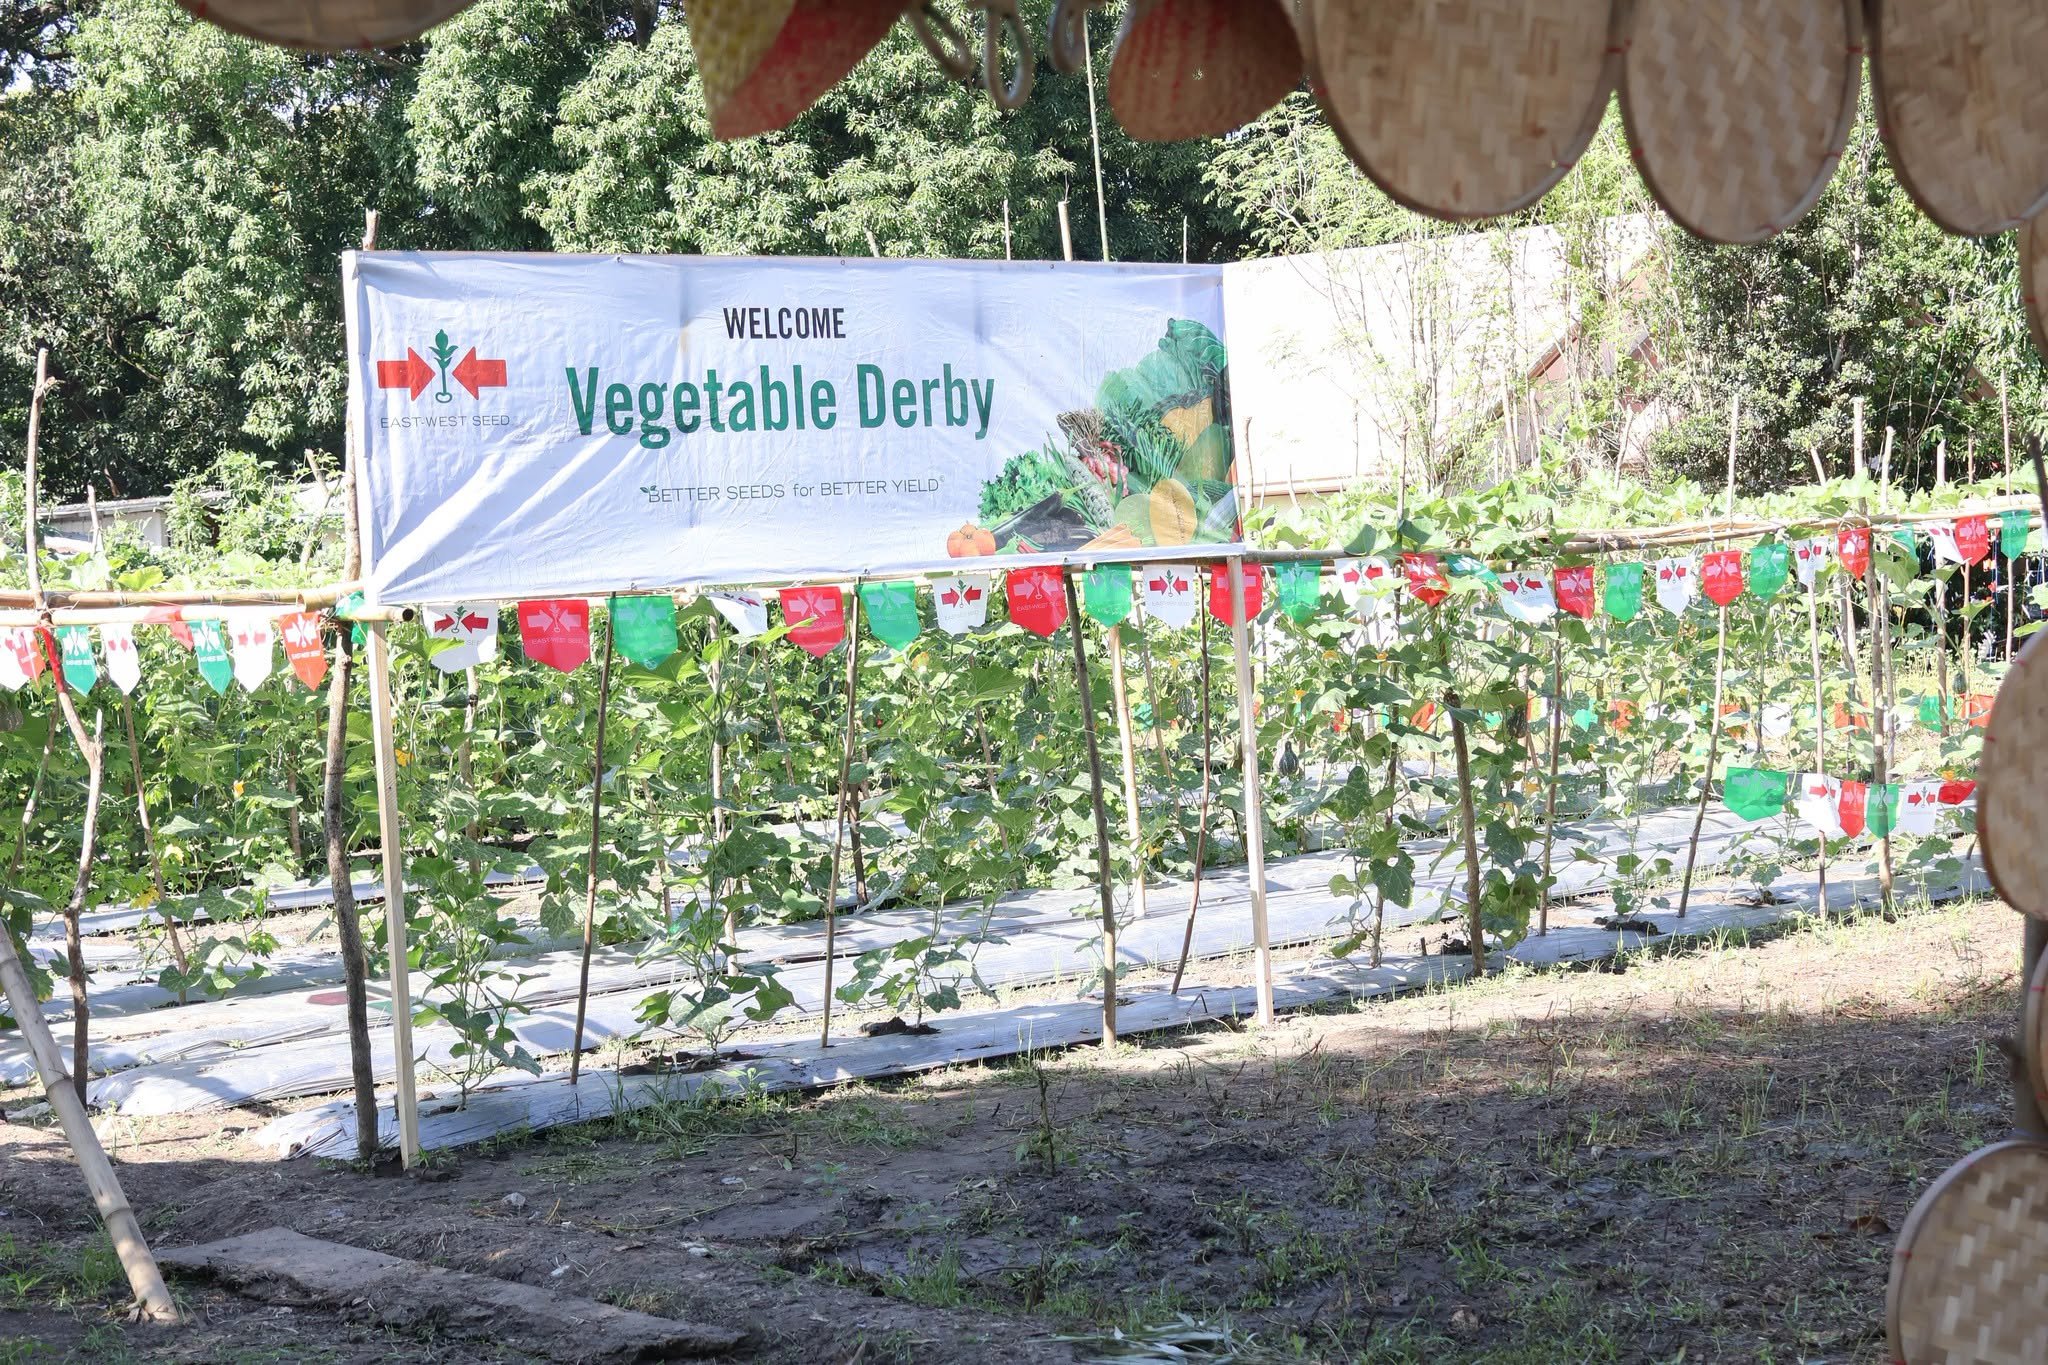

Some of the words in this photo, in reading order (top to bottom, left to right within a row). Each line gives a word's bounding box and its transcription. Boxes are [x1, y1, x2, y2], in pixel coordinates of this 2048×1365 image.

[723, 307, 846, 340] WELCOME
[565, 364, 837, 450] Vegetable
[856, 363, 995, 441] Derby
[380, 416, 467, 429] EAST-WEST
[472, 414, 511, 427] SEED
[649, 486, 721, 503] BETTER
[726, 483, 785, 500] SEEDS
[792, 483, 815, 497] for
[820, 480, 888, 496] BETTER
[891, 478, 939, 493] YIELD
